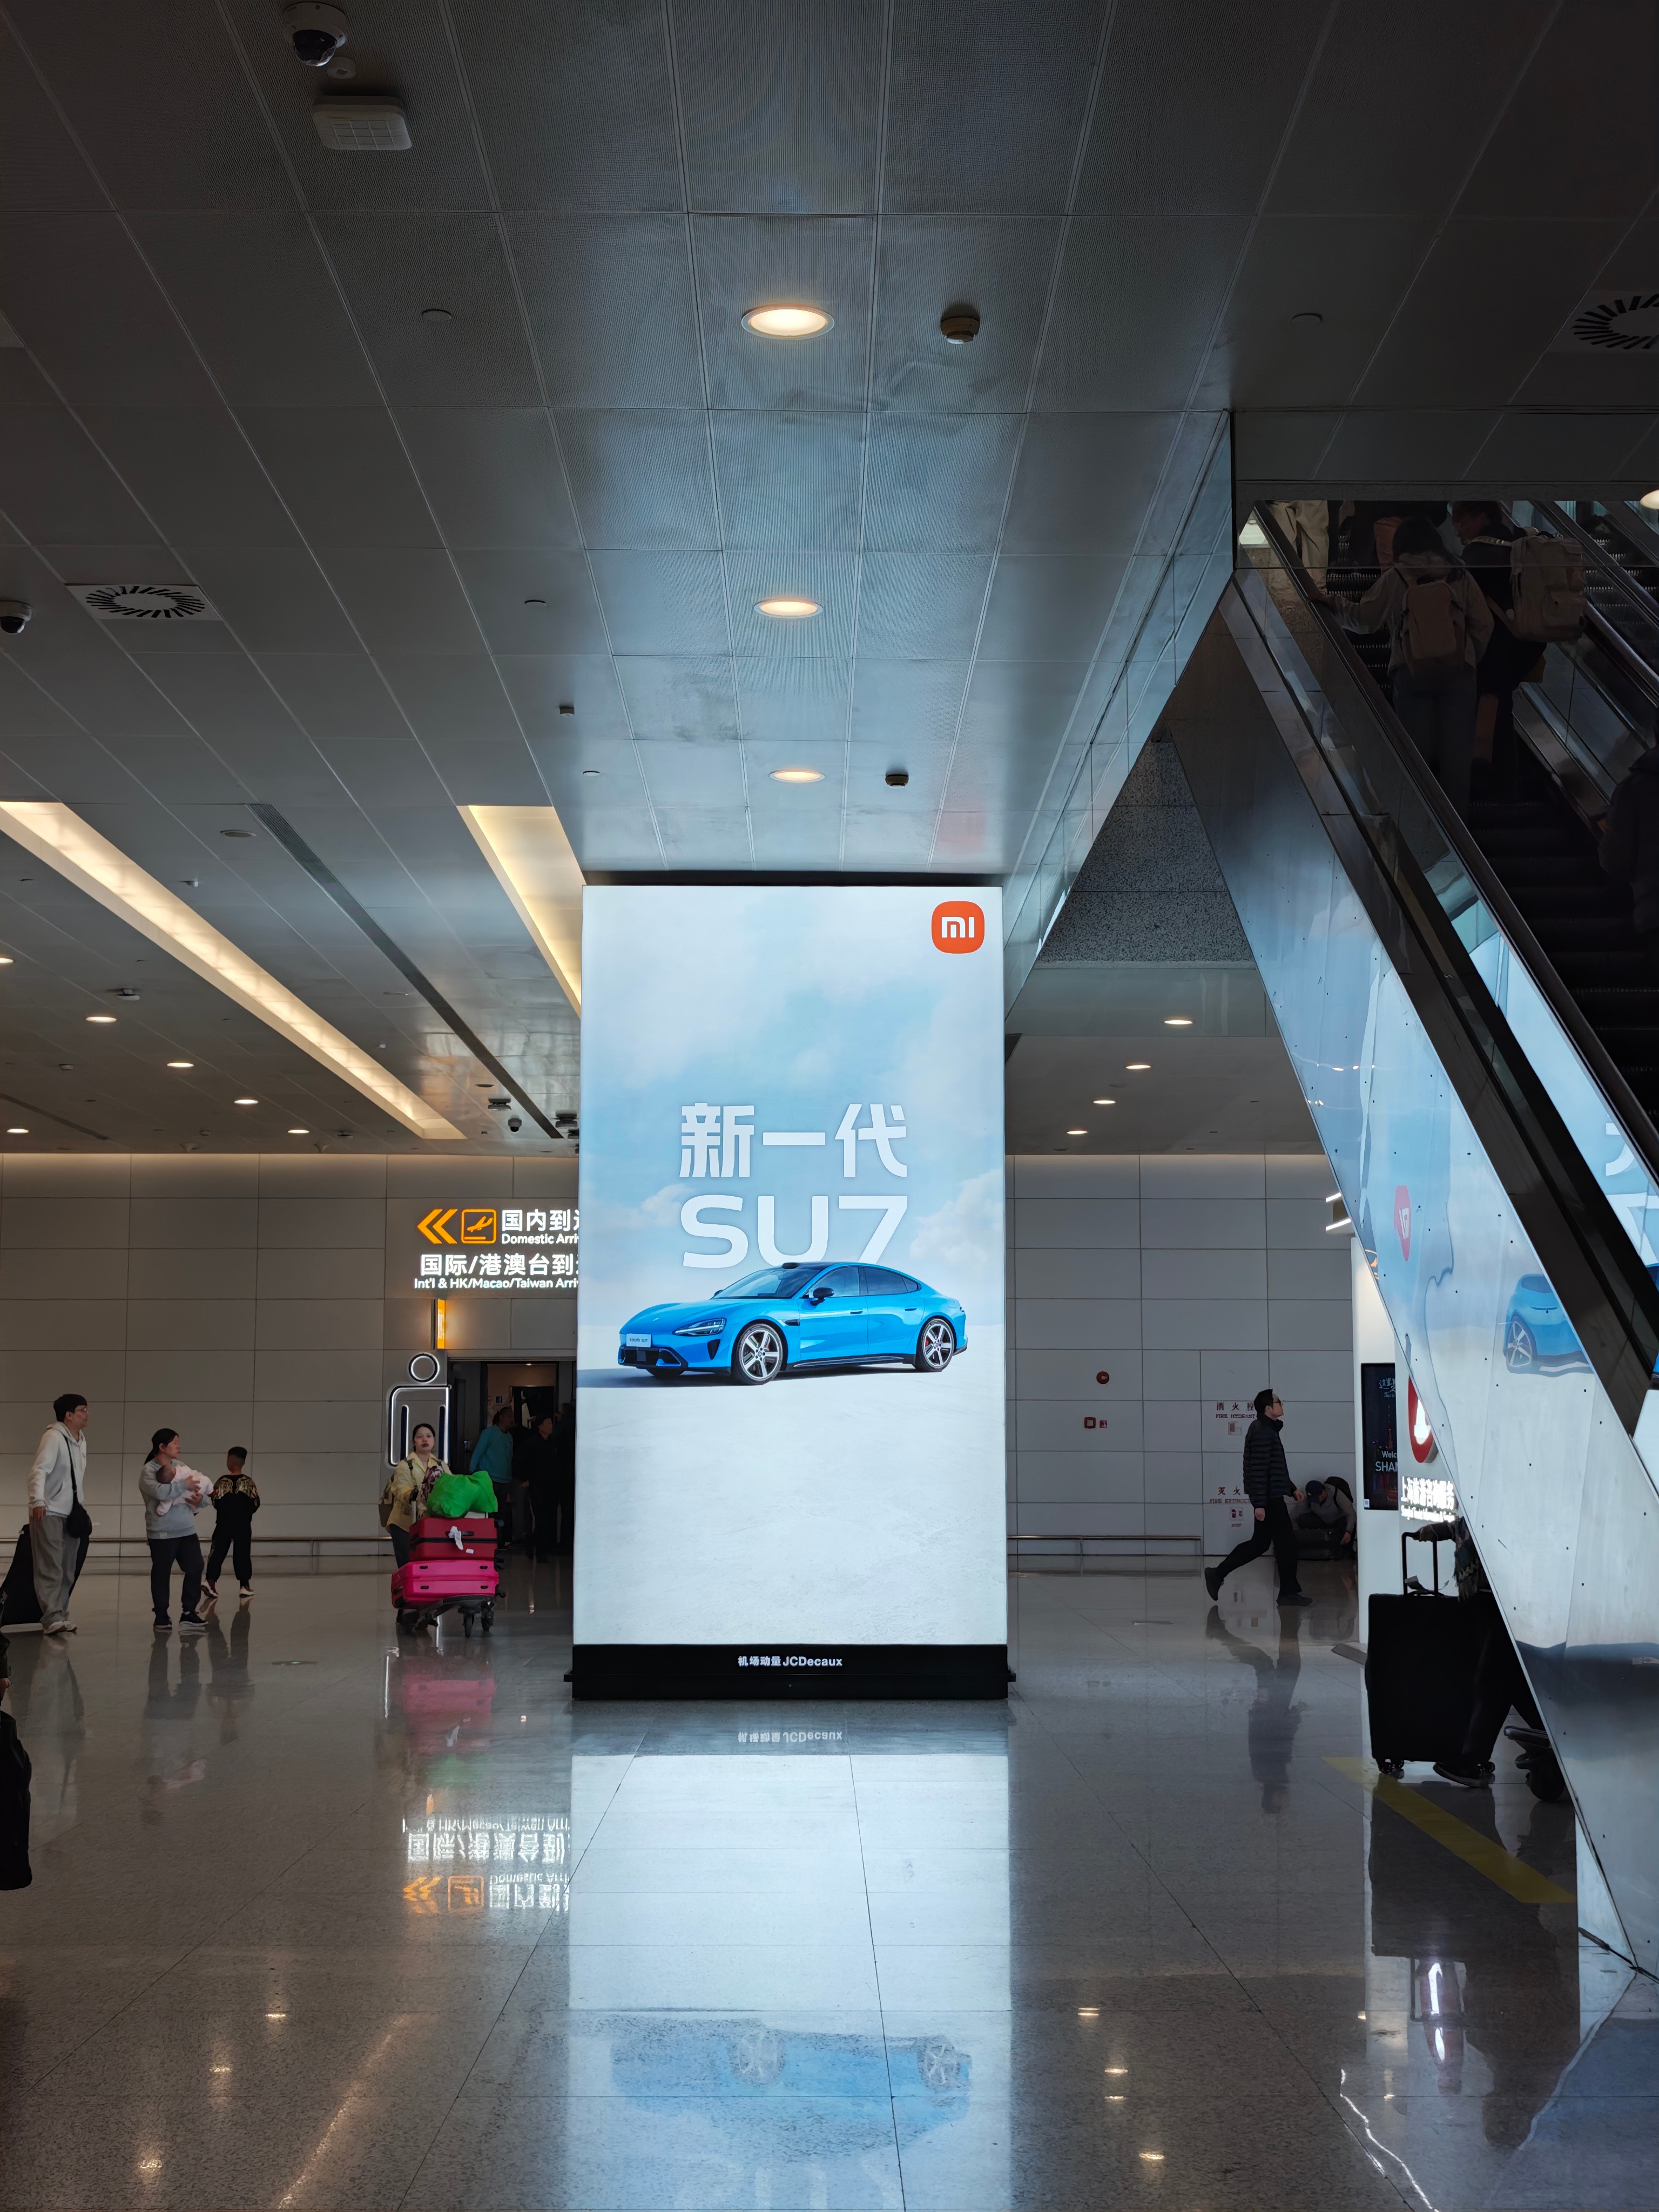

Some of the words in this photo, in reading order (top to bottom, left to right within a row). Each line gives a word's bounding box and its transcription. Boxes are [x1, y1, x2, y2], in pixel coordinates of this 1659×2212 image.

[679, 1102, 908, 1178] 新一代
[501, 1233, 554, 1244] Domestic
[556, 1233, 579, 1244] Arri
[680, 1195, 908, 1269] SU7
[421, 1253, 578, 1276] 国际/港澳台到
[414, 1278, 435, 1289] Int'l
[438, 1278, 448, 1289] &
[450, 1278, 553, 1289] HK/Macao/Taiwan
[555, 1278, 578, 1289] Arri
[783, 1656, 843, 1667] JCDecaux
